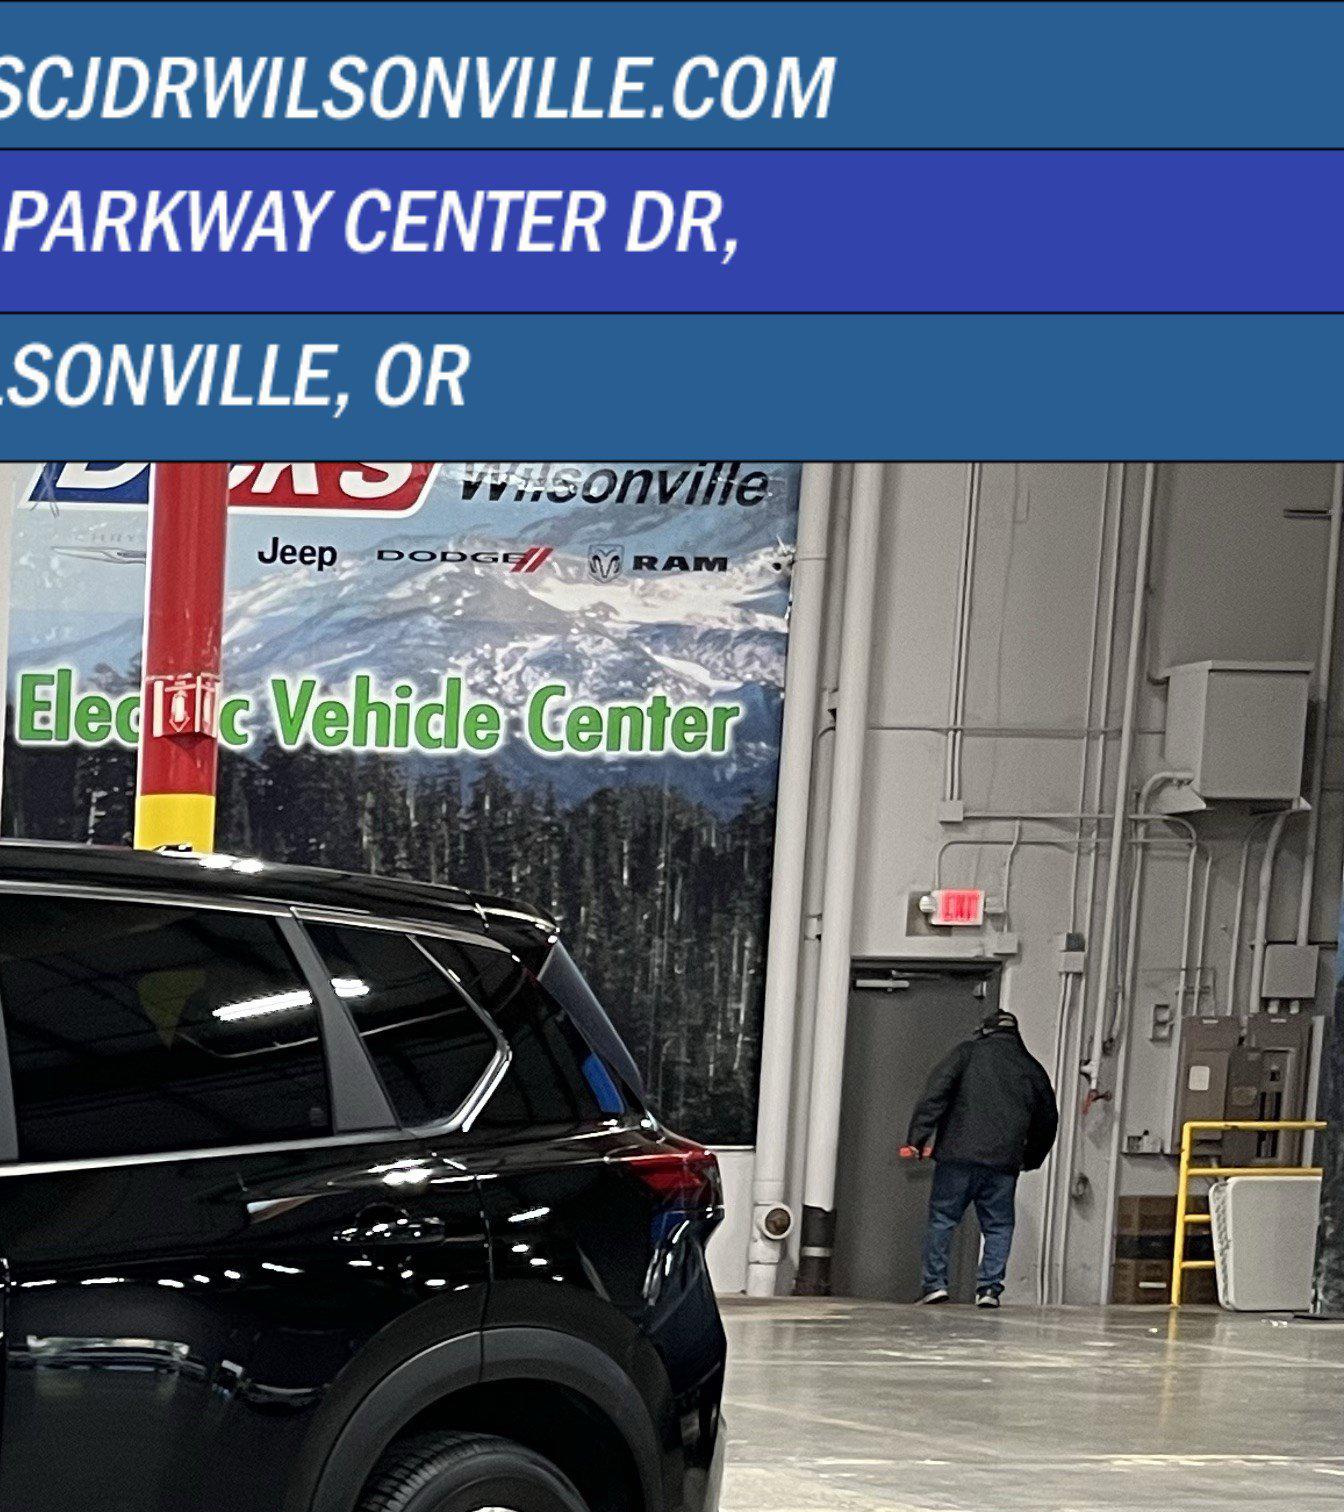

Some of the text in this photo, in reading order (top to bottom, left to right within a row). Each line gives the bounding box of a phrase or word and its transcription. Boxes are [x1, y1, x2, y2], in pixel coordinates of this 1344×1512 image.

[257, 536, 338, 572] Jeep
[376, 548, 526, 565] DODGE
[631, 554, 730, 573] RAM
[18, 668, 741, 752] Elecc Vehicle Center
